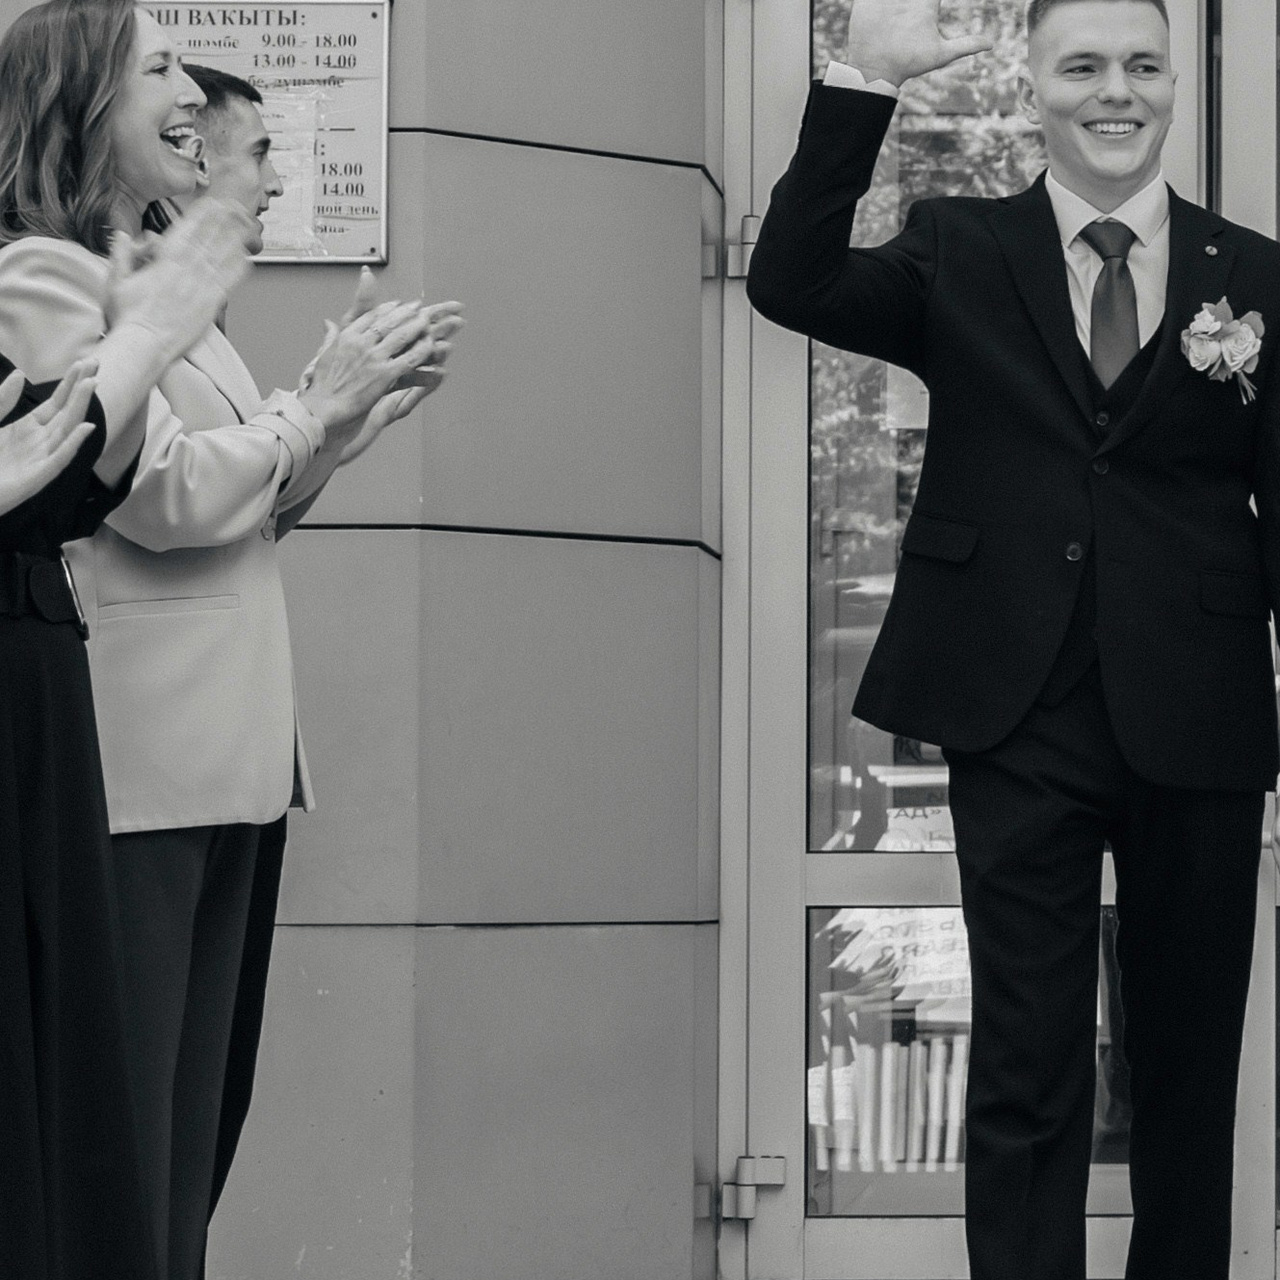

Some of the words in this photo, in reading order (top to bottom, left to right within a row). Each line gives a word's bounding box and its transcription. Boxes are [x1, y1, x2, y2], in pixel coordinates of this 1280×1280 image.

[261, 33, 296, 48] 9.00
[315, 33, 357, 48] 18.00
[253, 53, 296, 68] 13.00
[315, 53, 357, 69] 14.00
[321, 162, 363, 177] 18.00
[322, 183, 365, 196] 14.00
